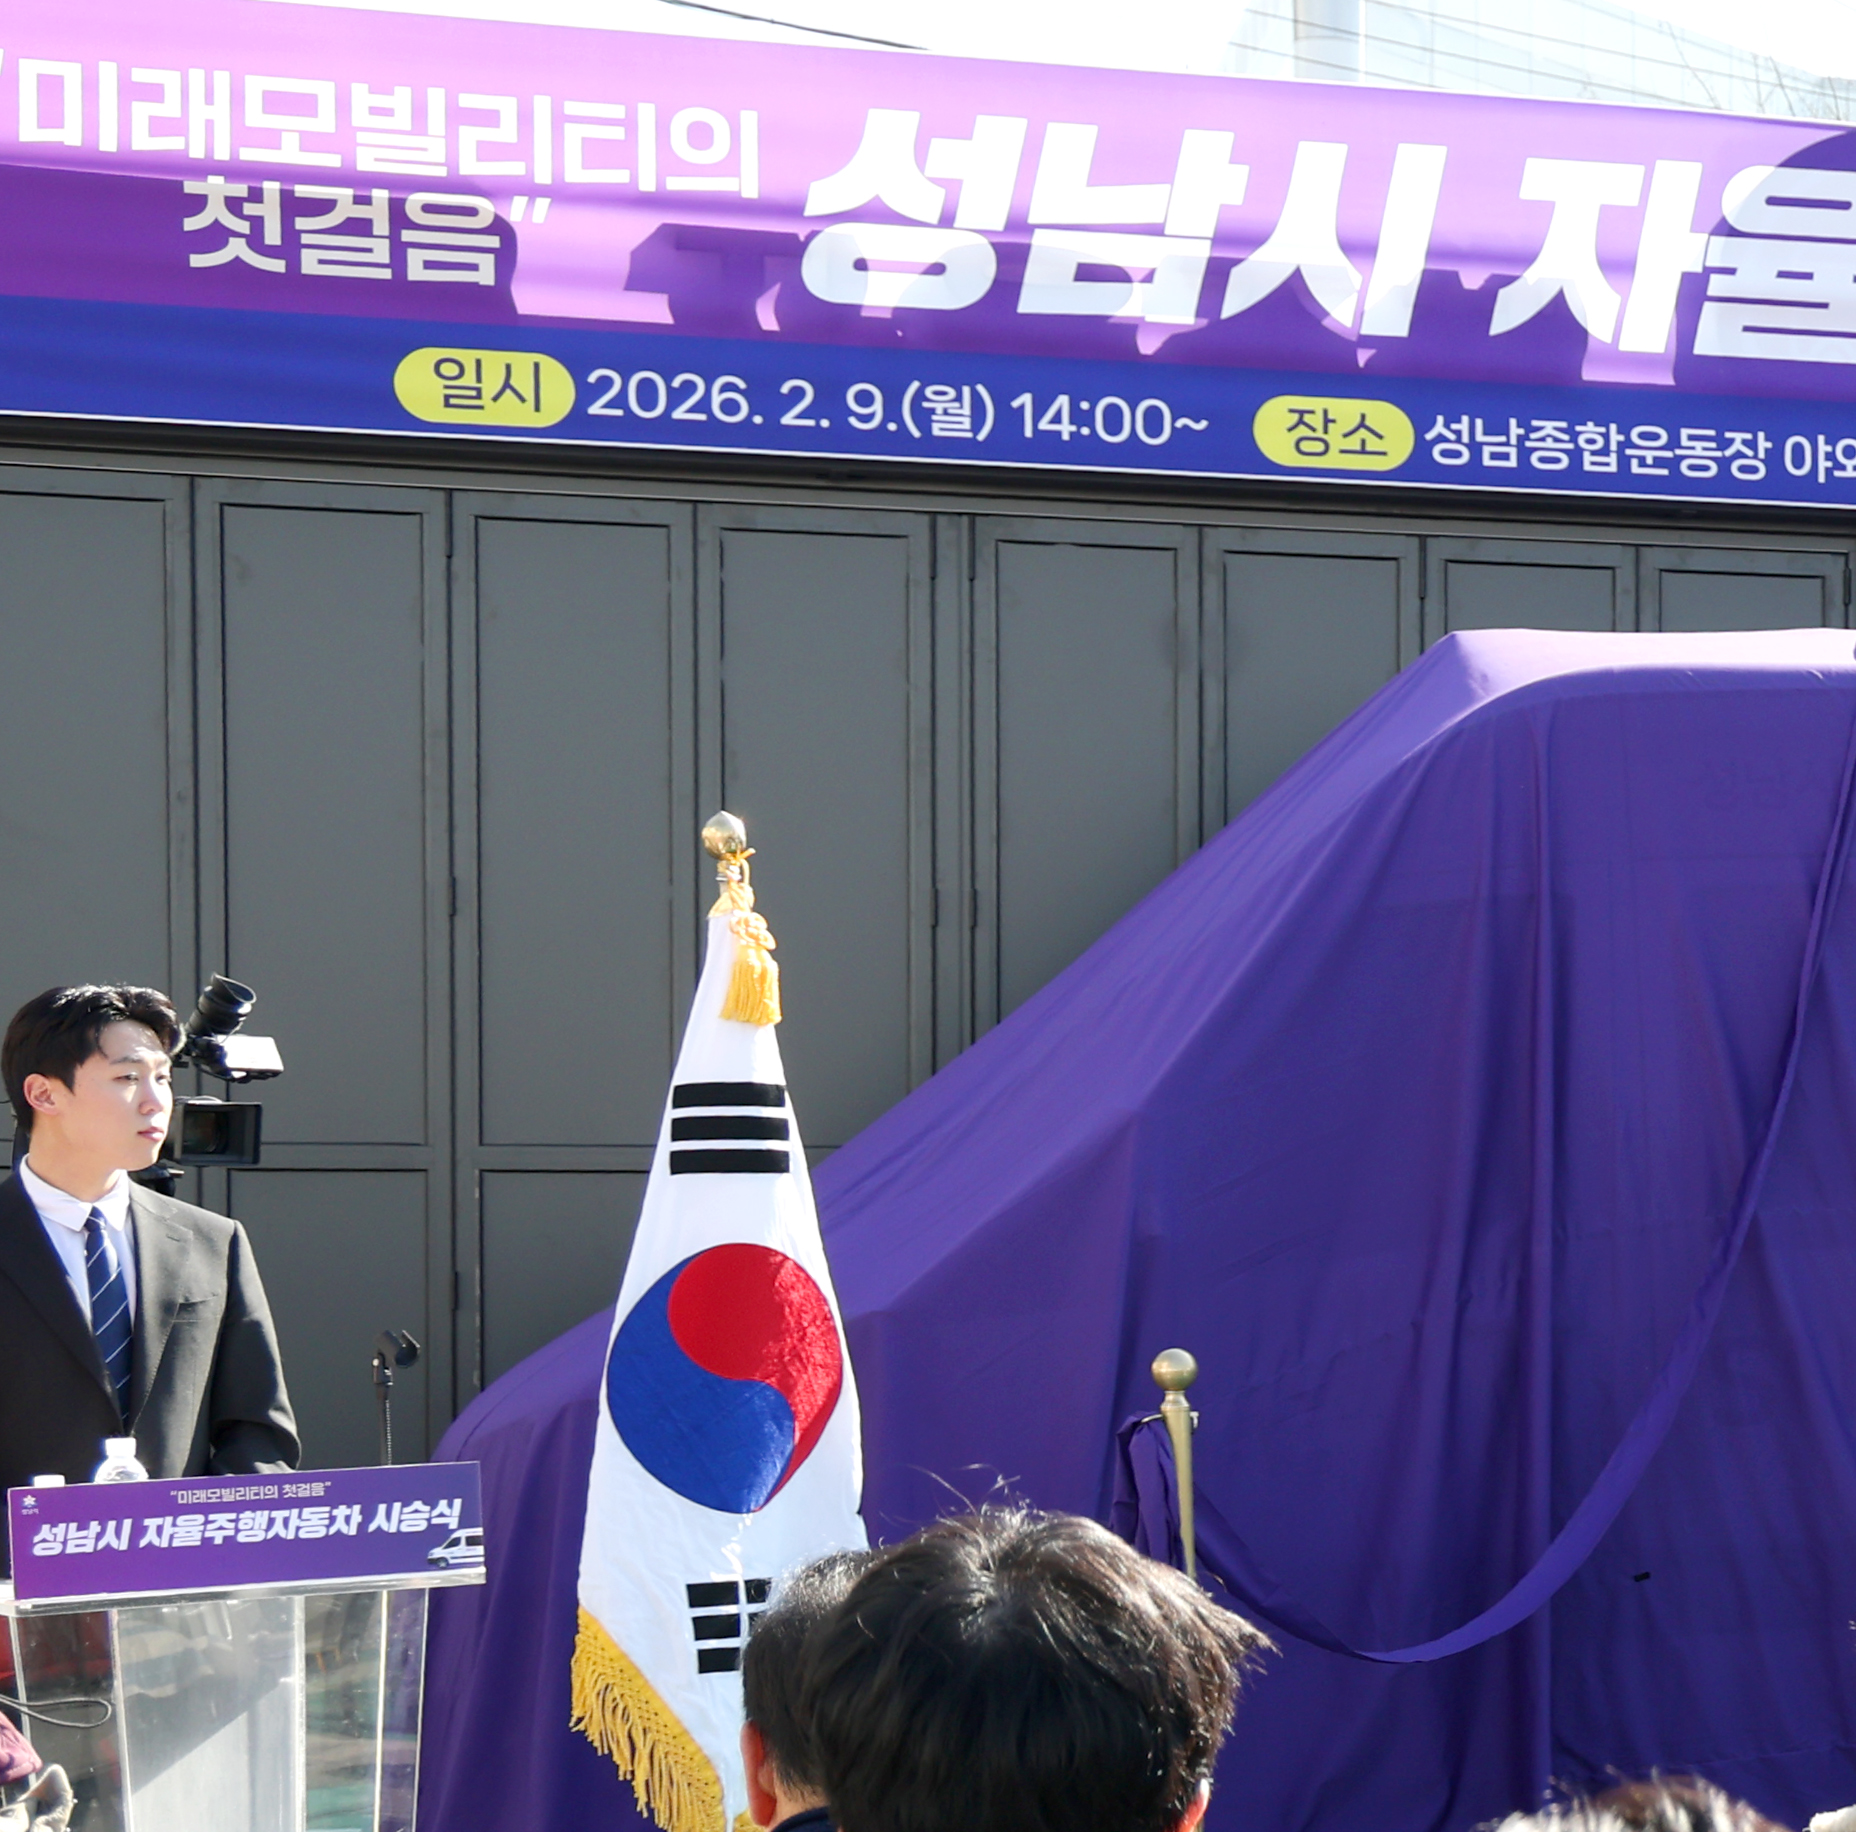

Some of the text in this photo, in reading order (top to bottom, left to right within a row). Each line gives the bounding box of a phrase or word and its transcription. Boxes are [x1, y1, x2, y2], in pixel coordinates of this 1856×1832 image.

[0, 47, 760, 200] 미래모빌리티의
[801, 108, 1448, 338] 성남시
[431, 355, 546, 414] 일시
[586, 368, 764, 424] 2026.
[779, 378, 831, 428] 2.
[845, 379, 995, 442] 9.(월)
[1010, 392, 1209, 446] 14:00~
[1284, 407, 1389, 458] 장소
[1423, 413, 1771, 479] 성남종합운동장
[32, 1498, 464, 1557] 성남시 자율주행자동차 시승식
